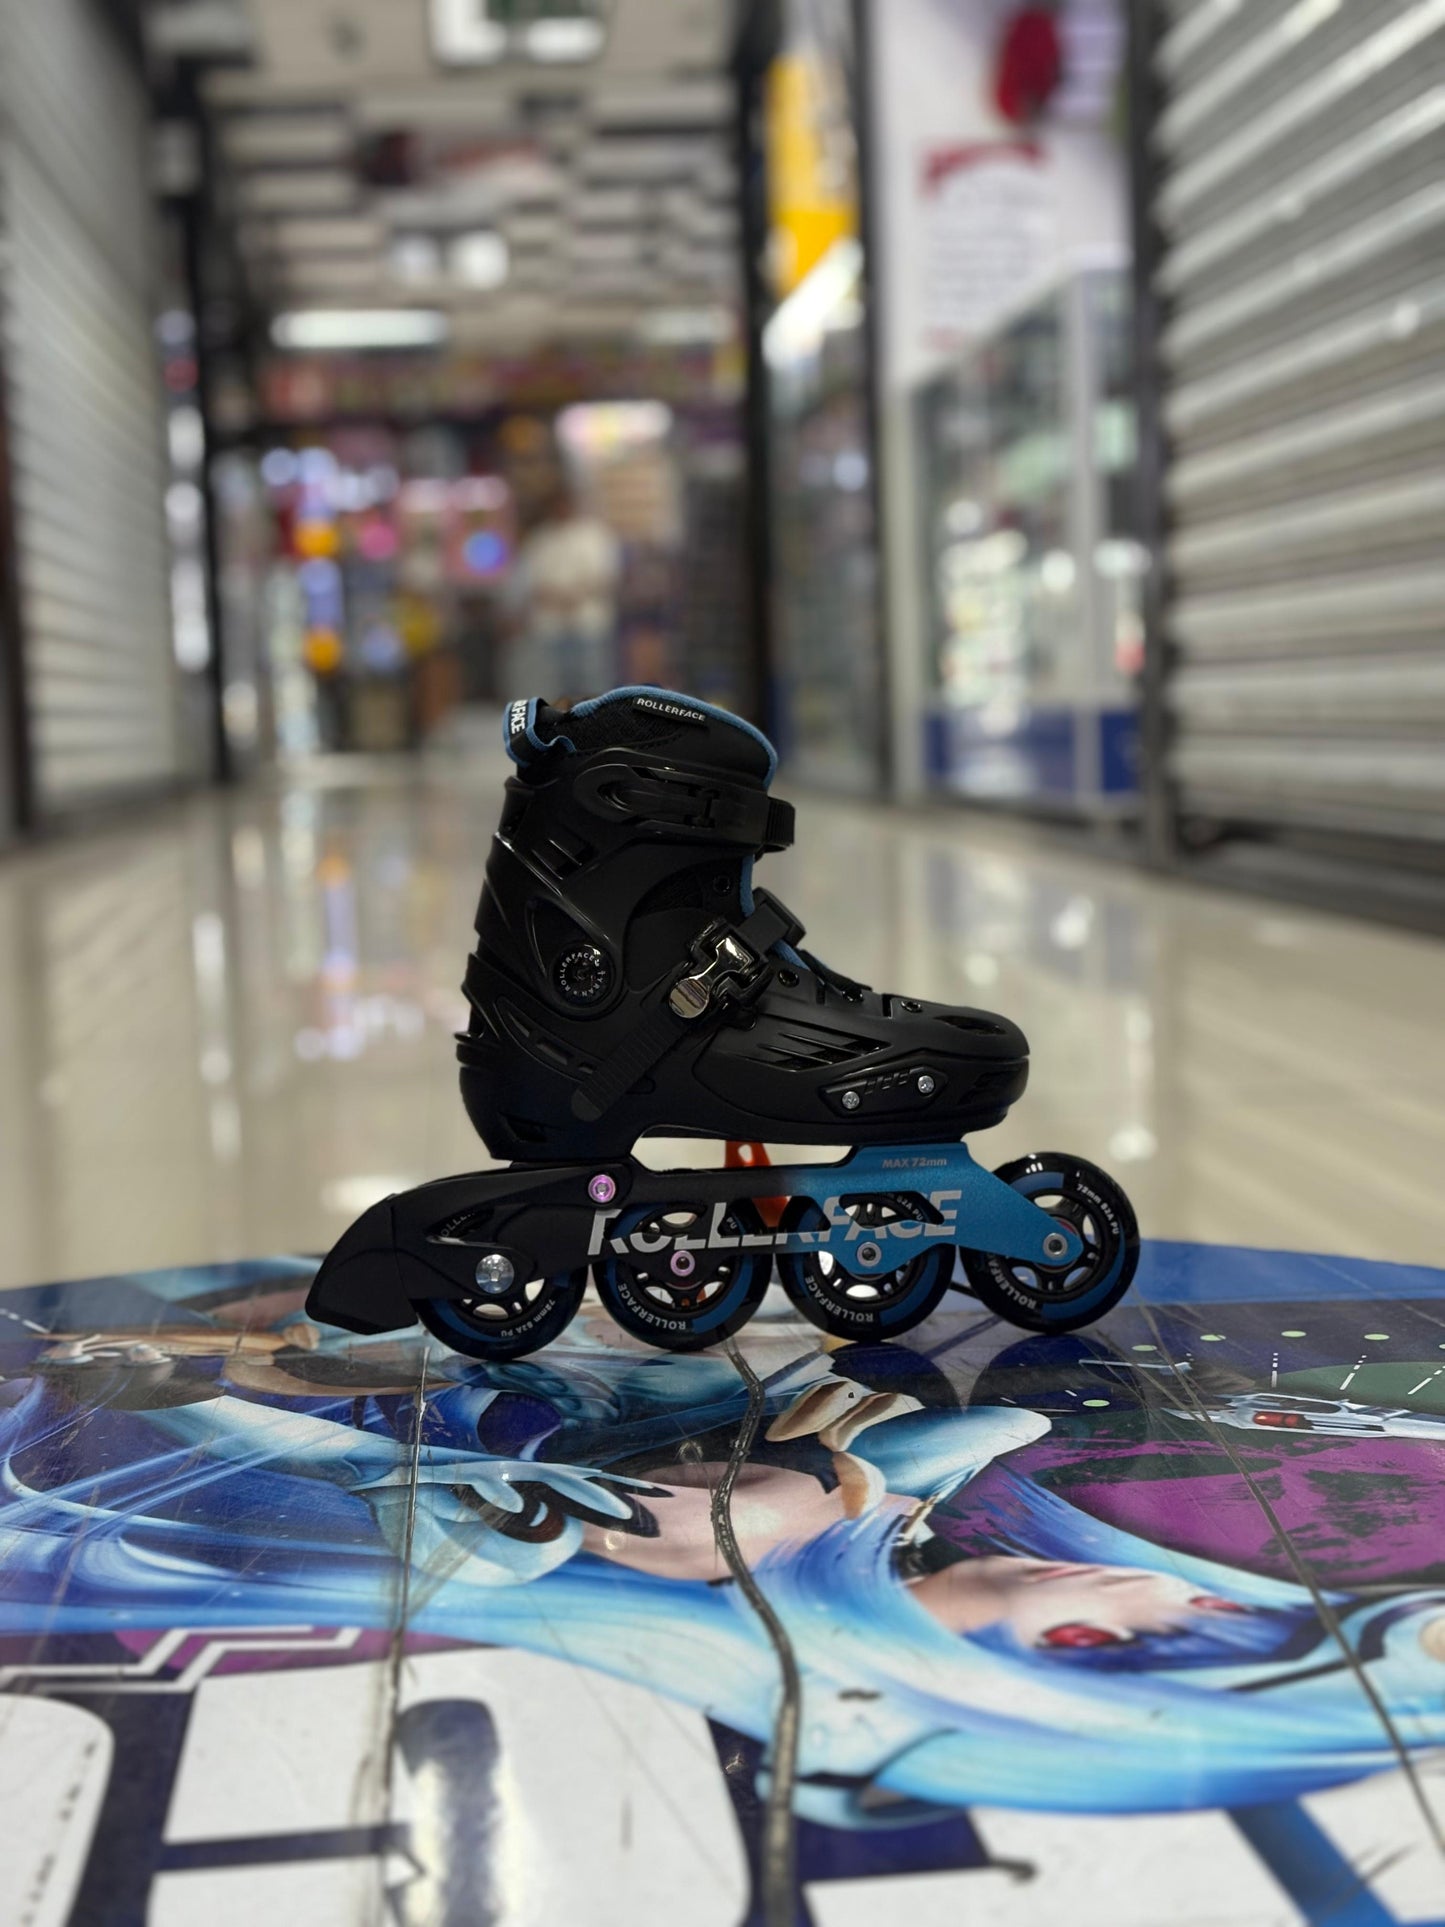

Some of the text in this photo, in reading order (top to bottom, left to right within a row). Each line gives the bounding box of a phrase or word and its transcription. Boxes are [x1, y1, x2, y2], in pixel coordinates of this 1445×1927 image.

[637, 698, 706, 721] ROLLERFACE
[882, 1157, 947, 1169] MAX 72mm
[1110, 1221, 1120, 1234] PU
[617, 1283, 686, 1330] ROLLERFACE
[805, 1275, 874, 1322] ROLLERFACE
